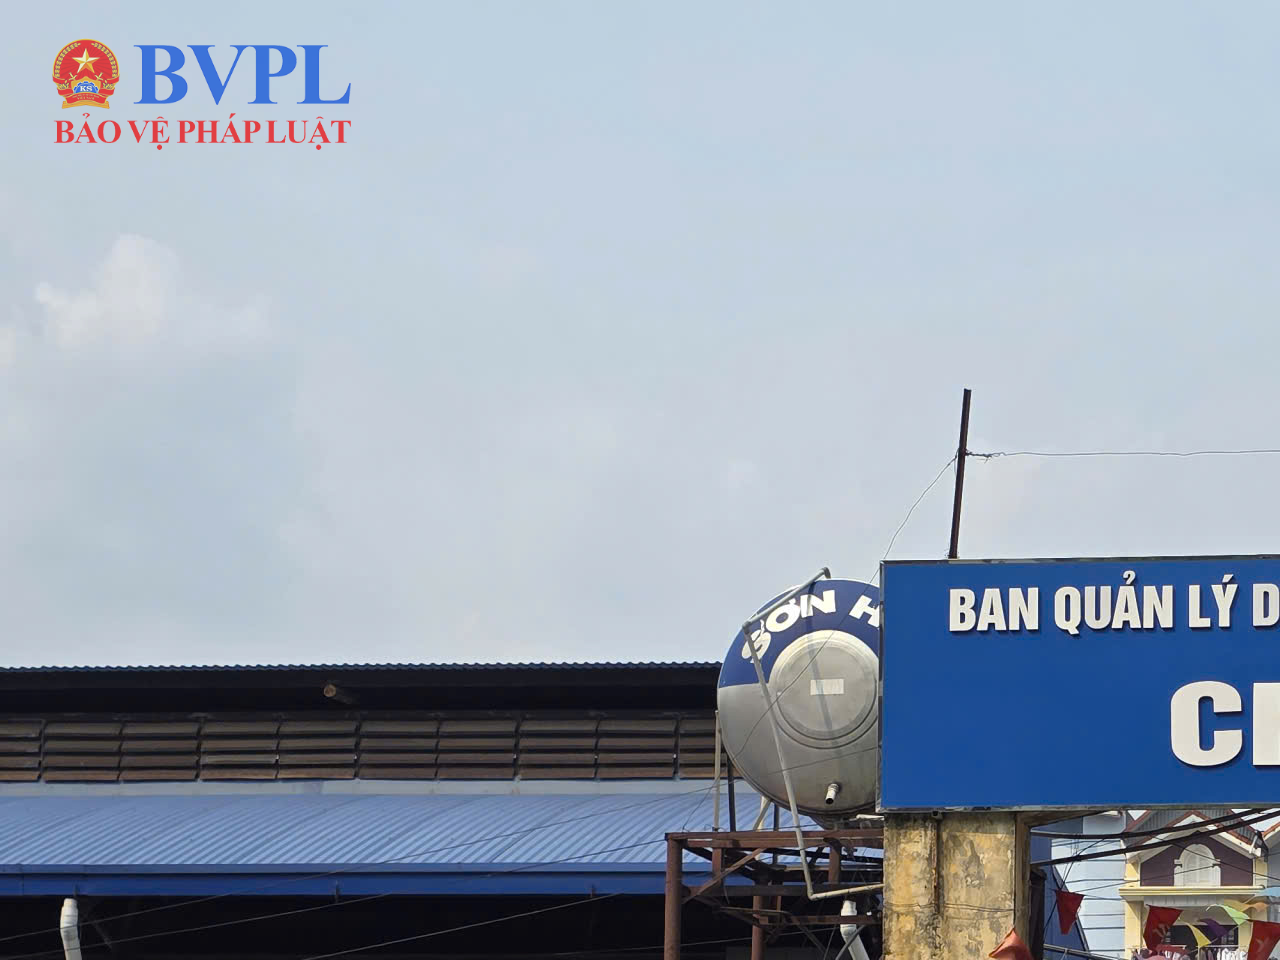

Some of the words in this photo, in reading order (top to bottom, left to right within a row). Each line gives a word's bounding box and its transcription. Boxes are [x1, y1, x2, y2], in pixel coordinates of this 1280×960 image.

[741, 589, 837, 664] SƠN
[949, 586, 1040, 632] BAN
[1054, 570, 1174, 635] QUẢN
[1188, 574, 1235, 629] LÝ
